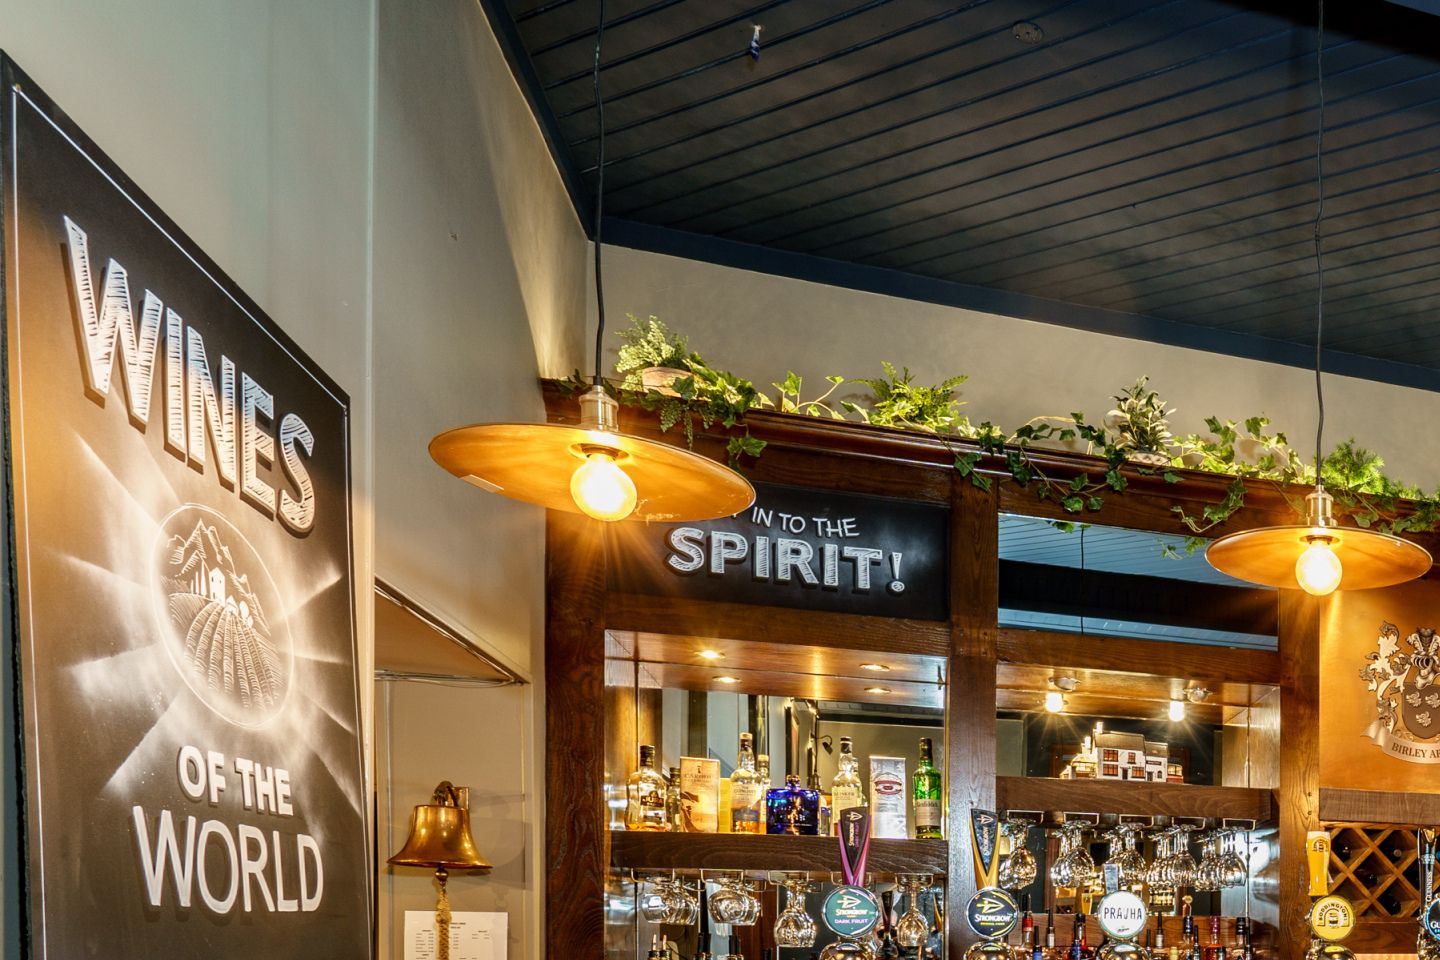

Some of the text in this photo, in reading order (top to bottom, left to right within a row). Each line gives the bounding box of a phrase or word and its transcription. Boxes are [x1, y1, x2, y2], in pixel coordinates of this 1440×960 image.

[64, 215, 316, 532] WINES
[752, 506, 860, 538] IN TO THE
[669, 526, 905, 592] SPIRIT!
[180, 745, 294, 816] OF THE
[1391, 742, 1427, 758] BIRLEY
[133, 806, 324, 913] WORLD
